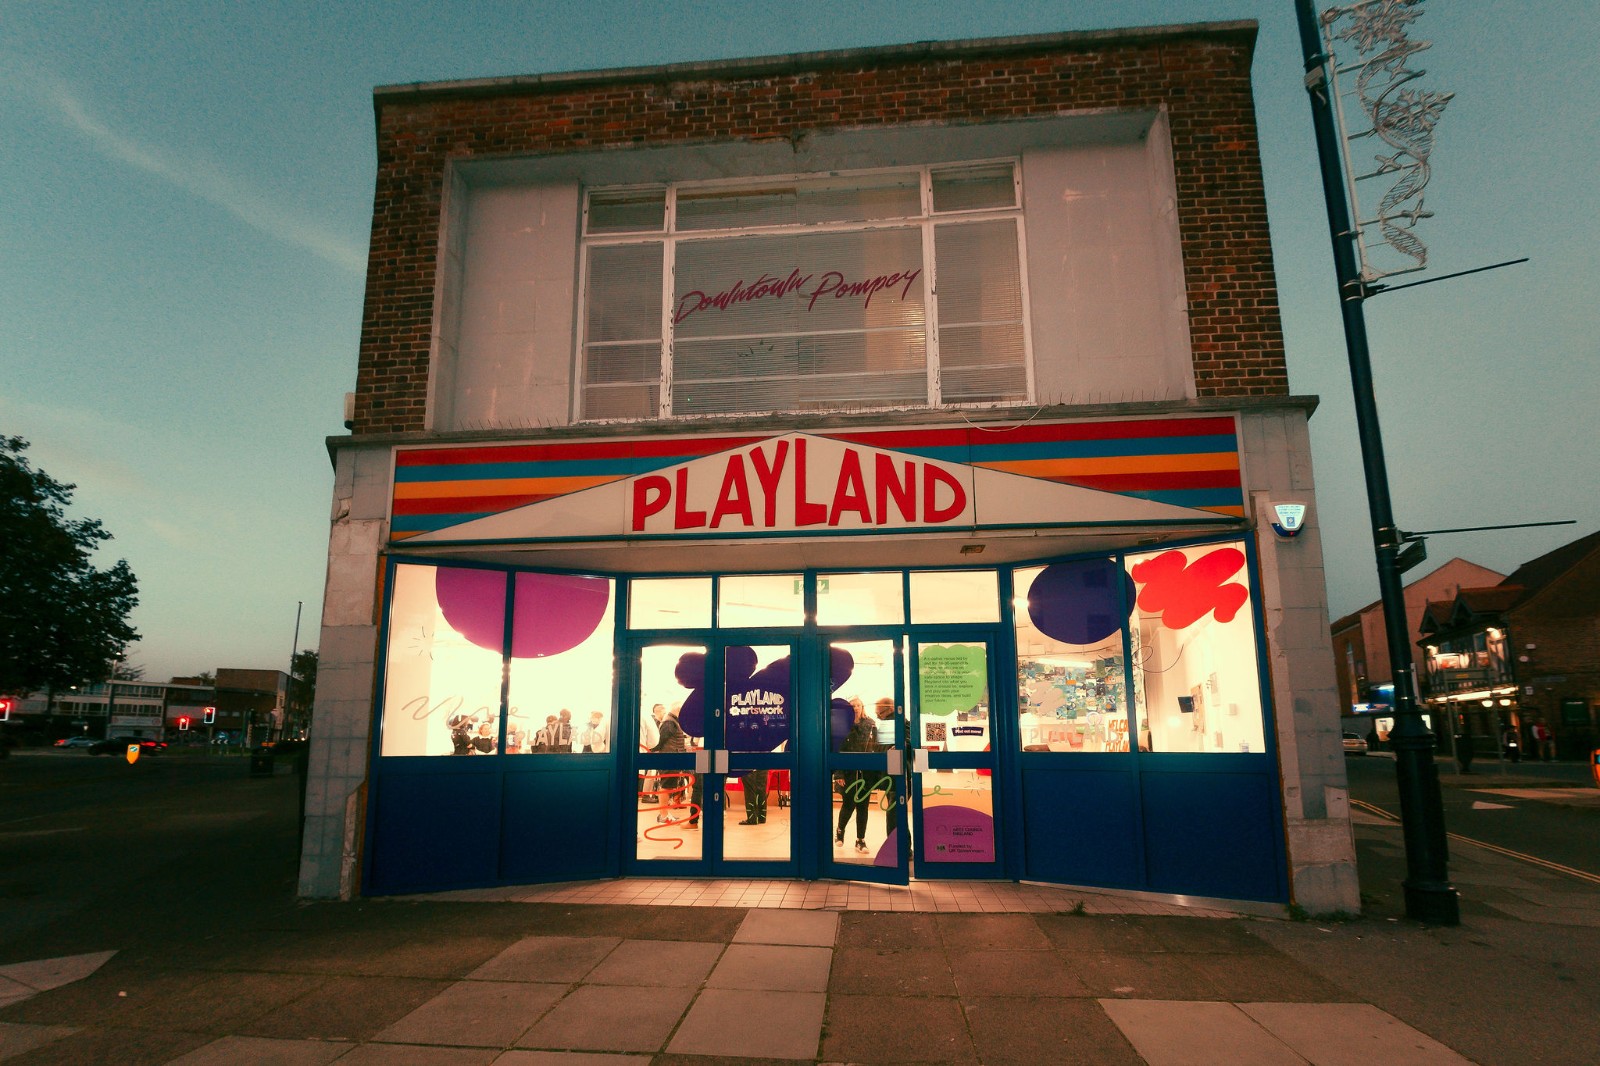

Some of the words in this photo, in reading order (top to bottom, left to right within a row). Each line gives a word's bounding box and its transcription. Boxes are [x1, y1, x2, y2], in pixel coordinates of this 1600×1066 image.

[674, 269, 812, 323] Downtown
[808, 269, 922, 311] Pompey
[632, 438, 966, 531] PLAYLAND
[732, 689, 784, 705] PLAYLAND
[740, 705, 783, 714] artswork
